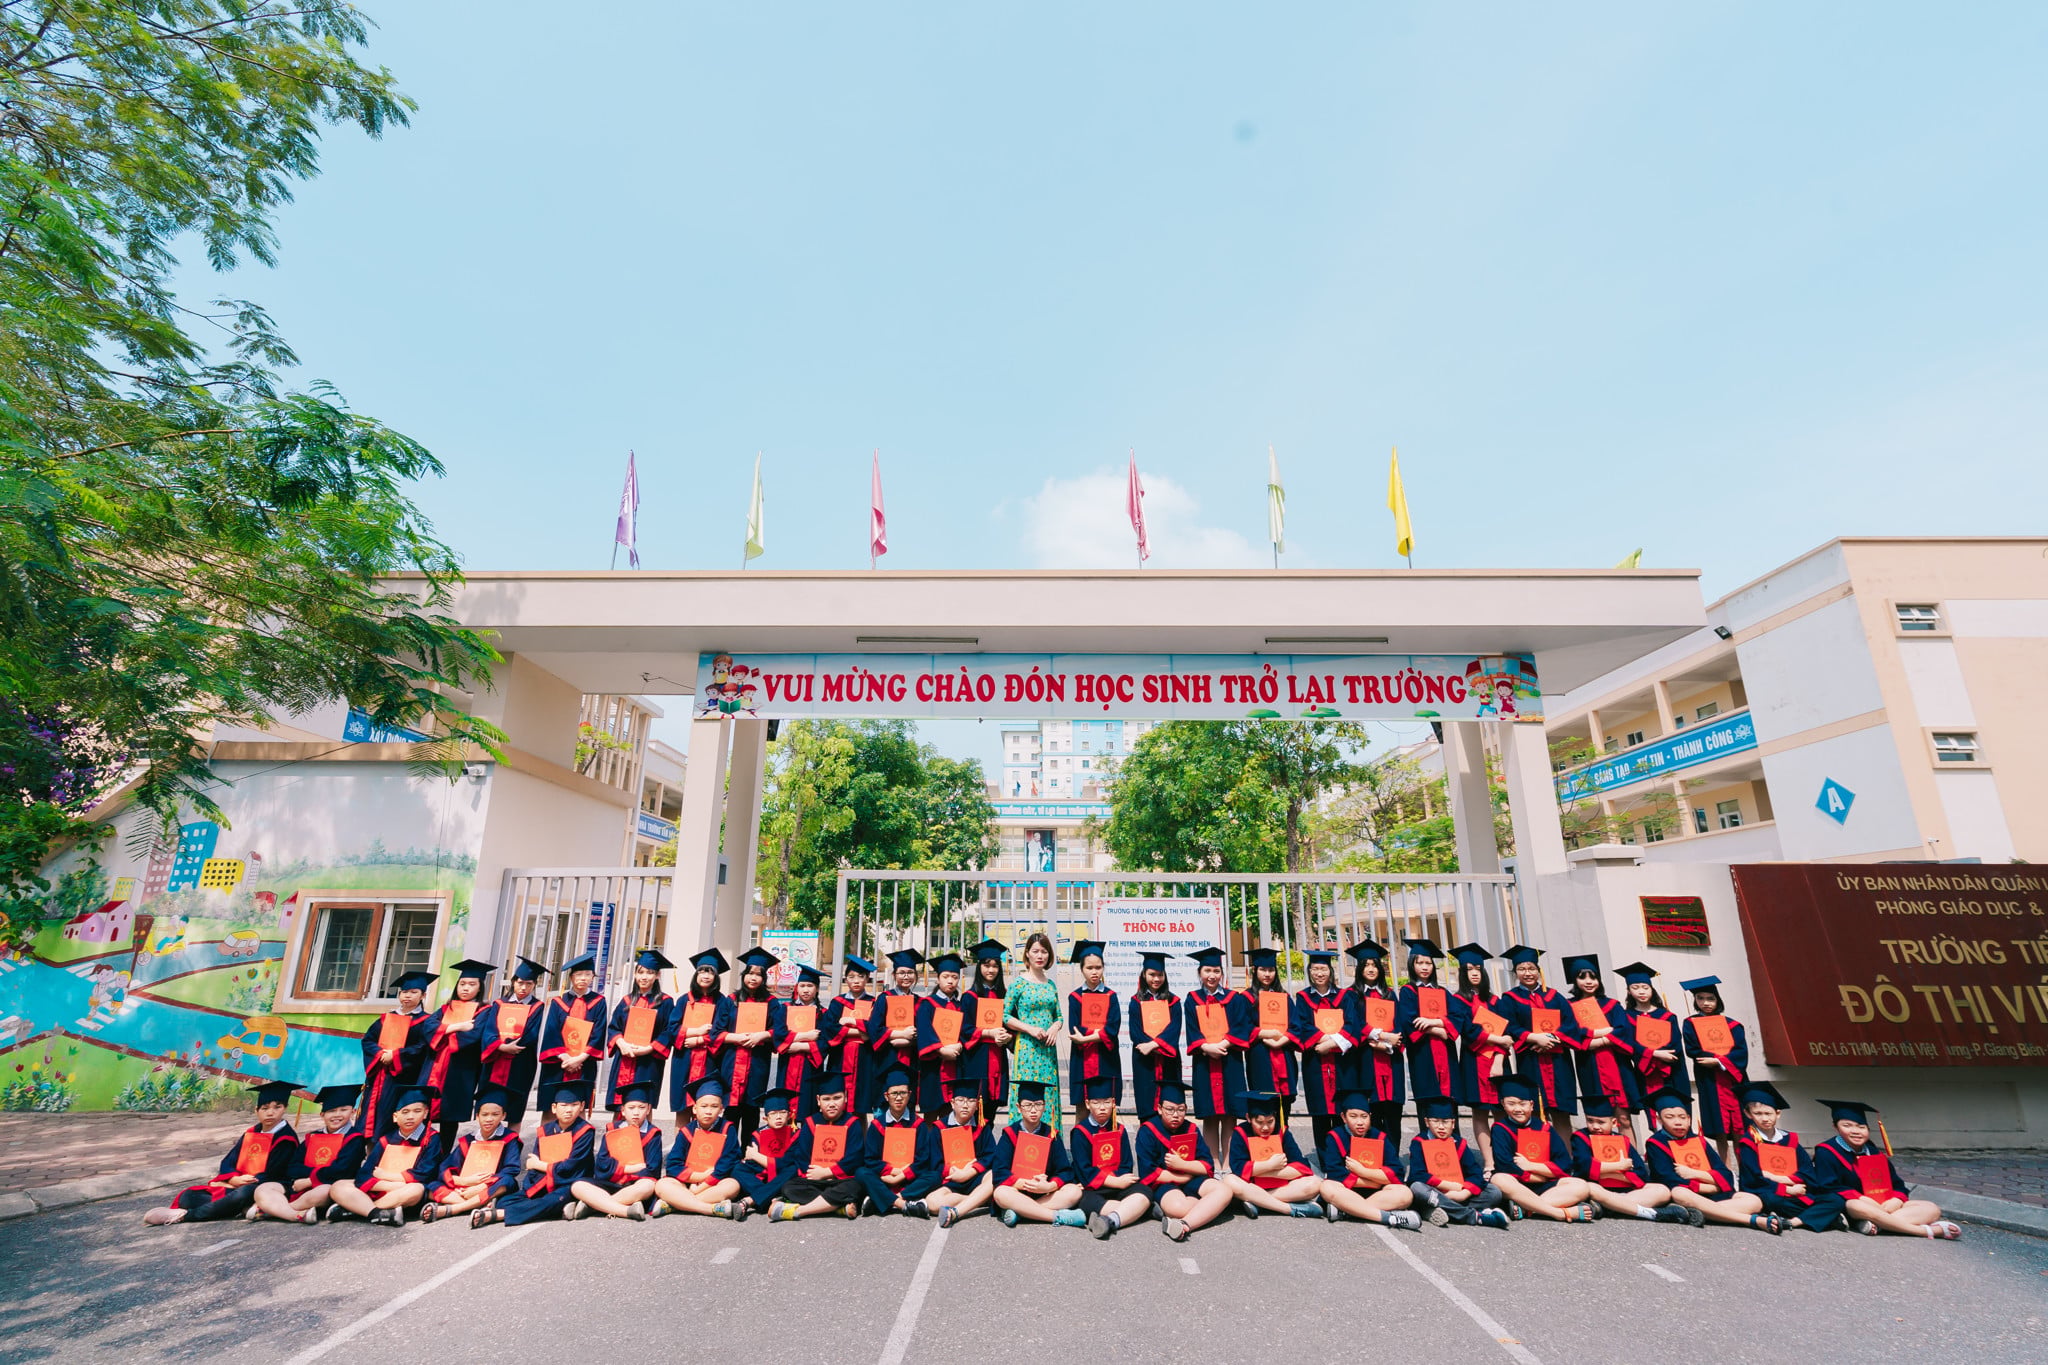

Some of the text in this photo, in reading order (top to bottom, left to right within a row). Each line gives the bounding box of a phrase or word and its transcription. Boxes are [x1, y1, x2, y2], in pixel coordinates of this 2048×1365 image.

[763, 663, 1467, 711] VUI MỪNG CHÀO ĐÓN HỌC SINH TRỞ LẠI TRƯỜNG
[1672, 738, 1704, 760] THÀNH
[1705, 729, 1735, 750] CÔNG
[1826, 786, 1846, 813] A
[1837, 872, 1860, 891] ỦY
[1864, 877, 1900, 891] BAN
[1902, 874, 1951, 891] NHÂN
[1952, 874, 1989, 891] DÂN
[1991, 874, 2041, 895] QUẬN
[1875, 897, 2045, 919] PHÒNG GIÁO DỤC &
[1123, 919, 1195, 933] THÔNG BÁO
[1880, 933, 2007, 965] TRƯỜNG
[1838, 974, 1911, 1024] ĐÔ
[1912, 984, 1999, 1034] THỊ
